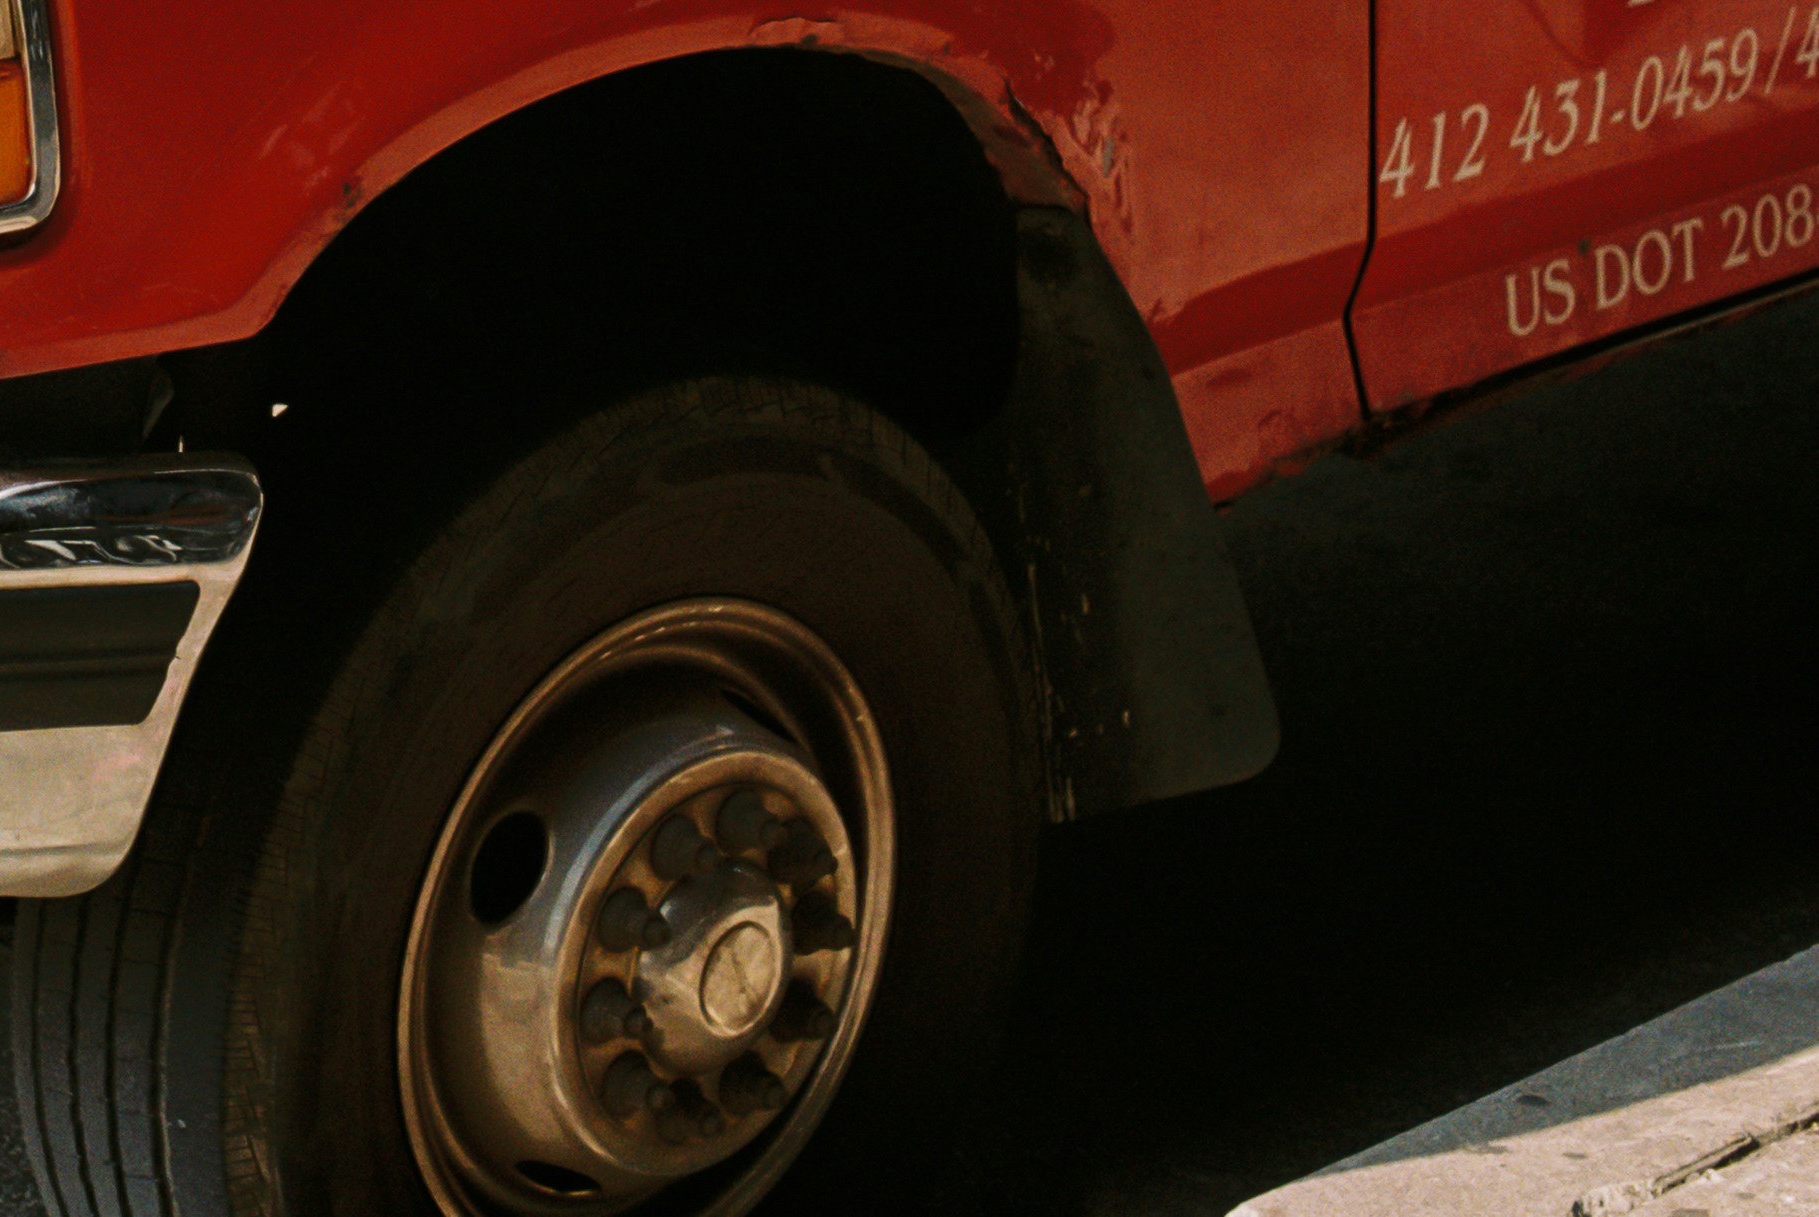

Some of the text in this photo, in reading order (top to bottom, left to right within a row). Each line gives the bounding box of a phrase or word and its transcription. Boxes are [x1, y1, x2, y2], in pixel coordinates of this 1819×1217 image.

[1380, 117, 1489, 199] 412
[1505, 259, 1576, 335] US
[1594, 217, 1703, 309] DOT
